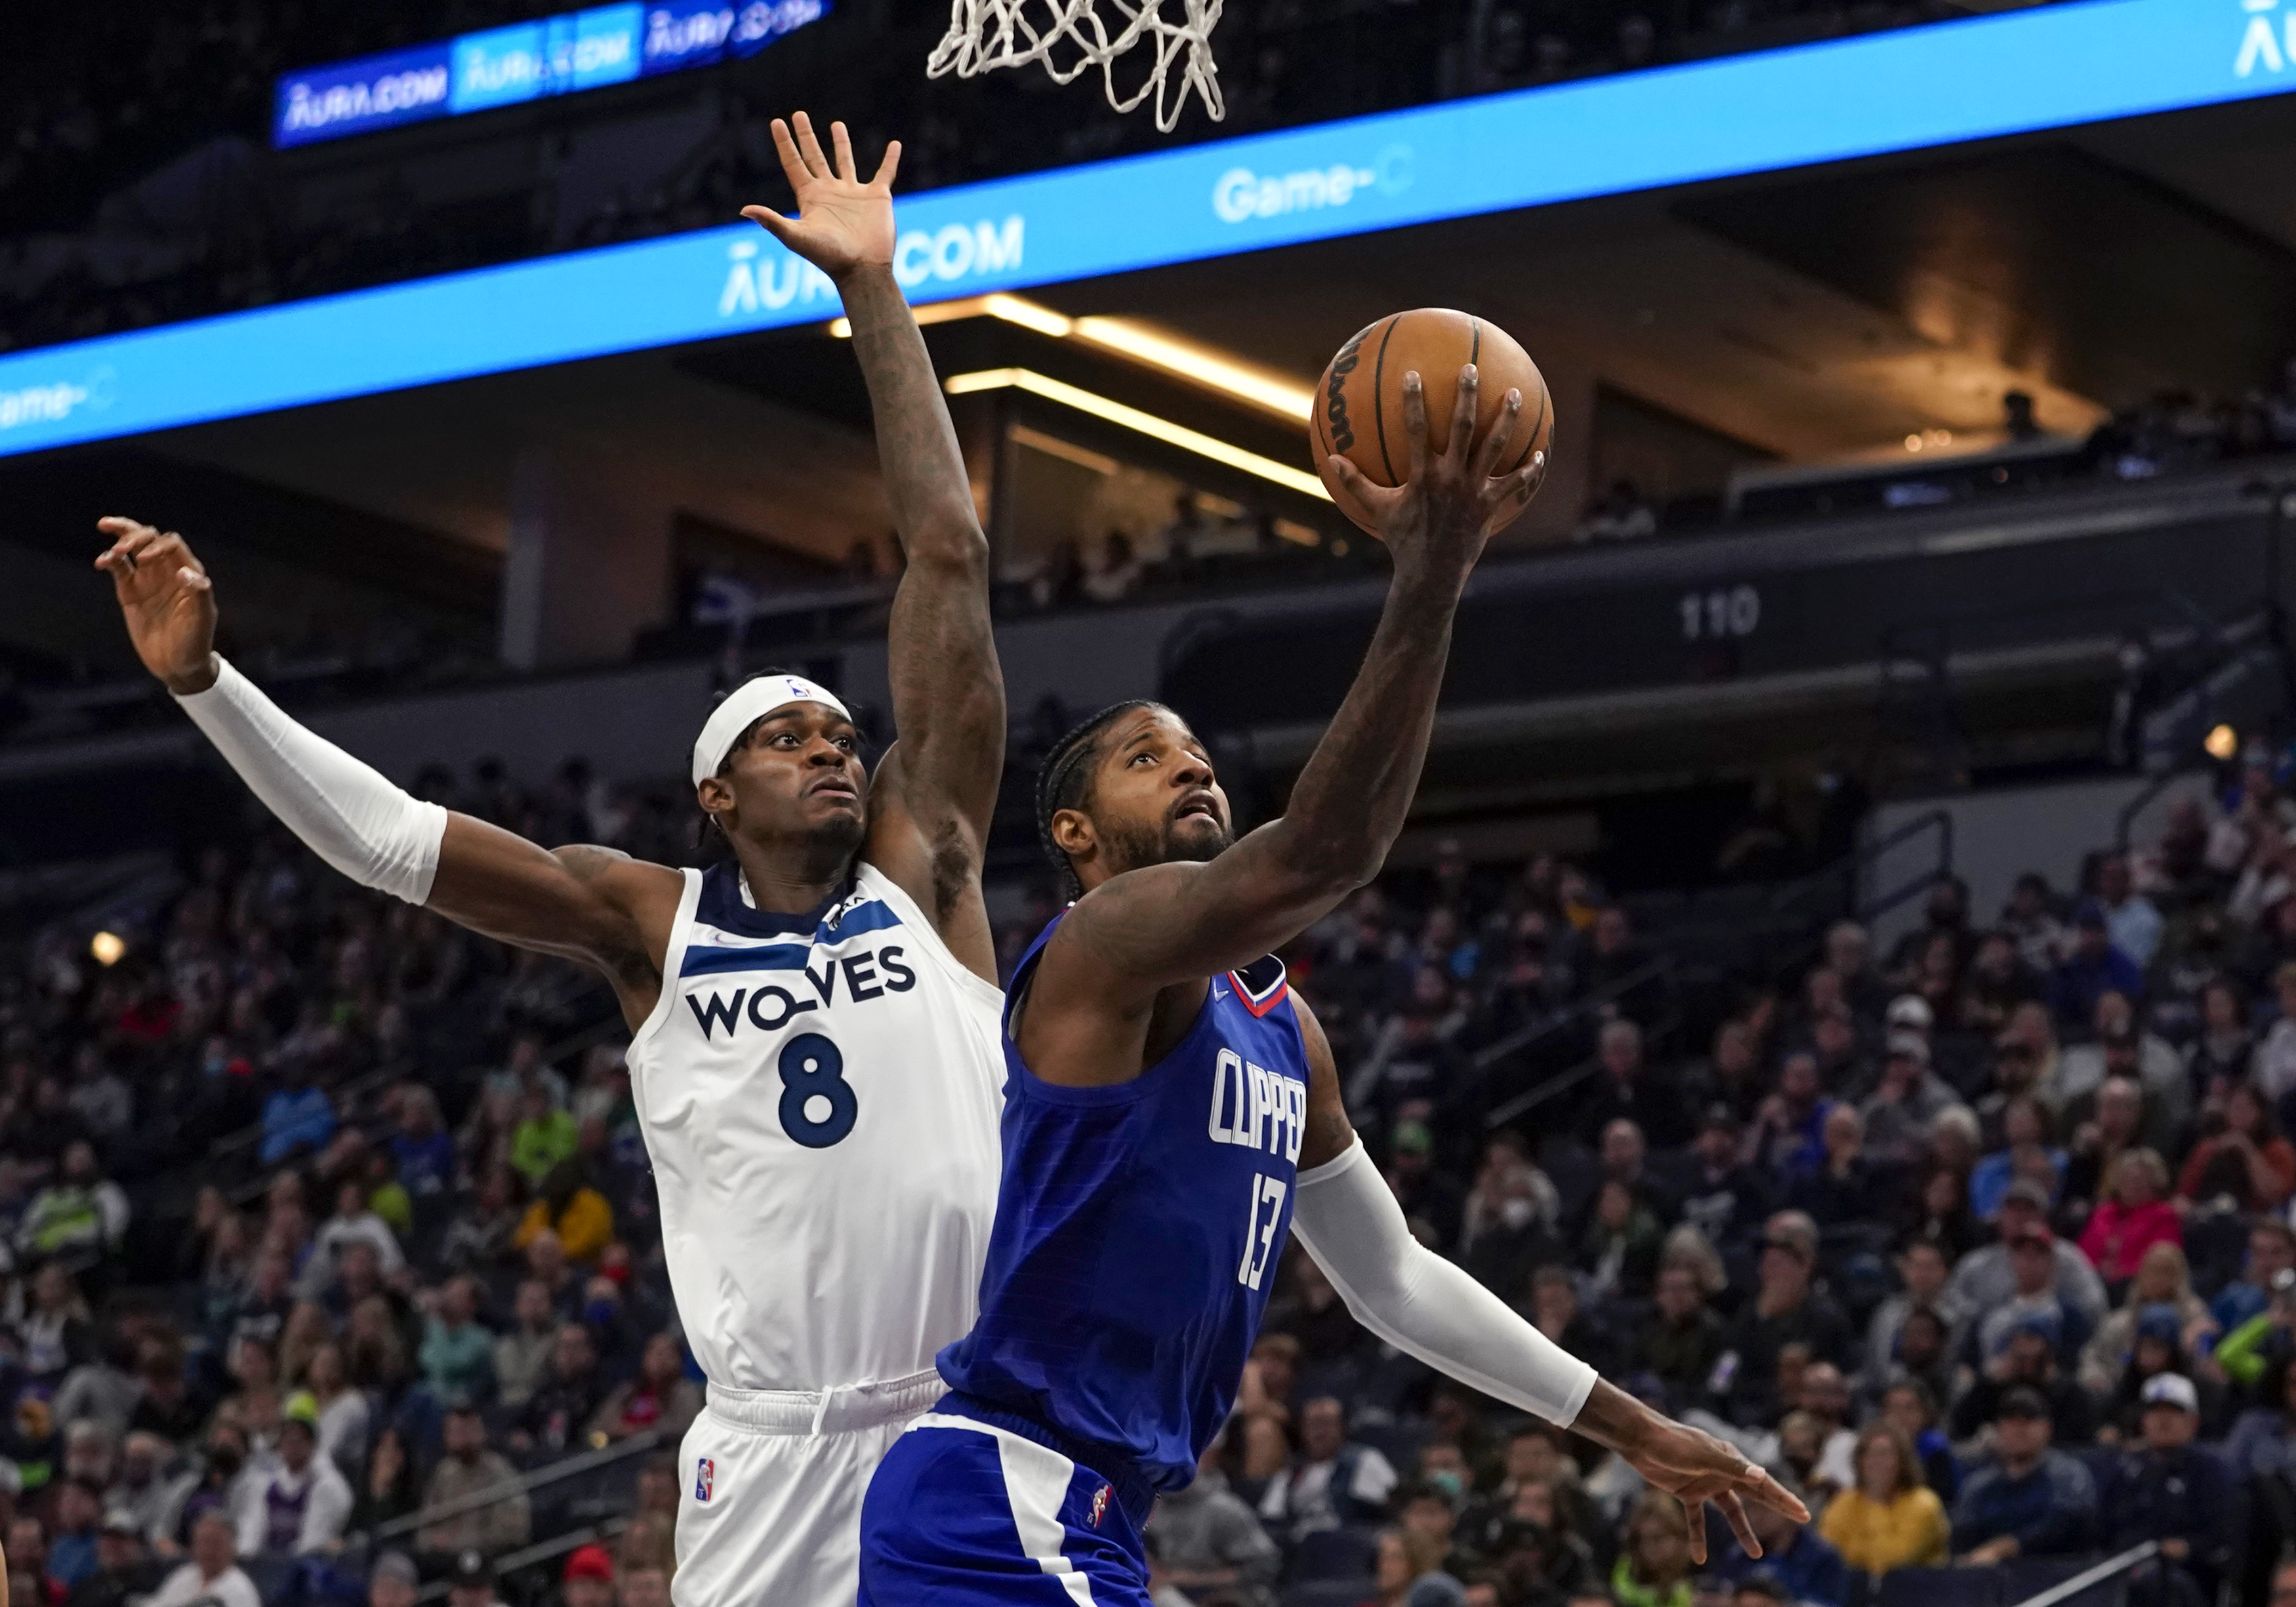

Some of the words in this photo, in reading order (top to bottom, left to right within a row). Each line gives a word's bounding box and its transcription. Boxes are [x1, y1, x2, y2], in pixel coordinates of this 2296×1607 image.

[1679, 584, 1761, 640] 110
[778, 1032, 858, 1149] 8
[1238, 1171, 1287, 1292] 13
